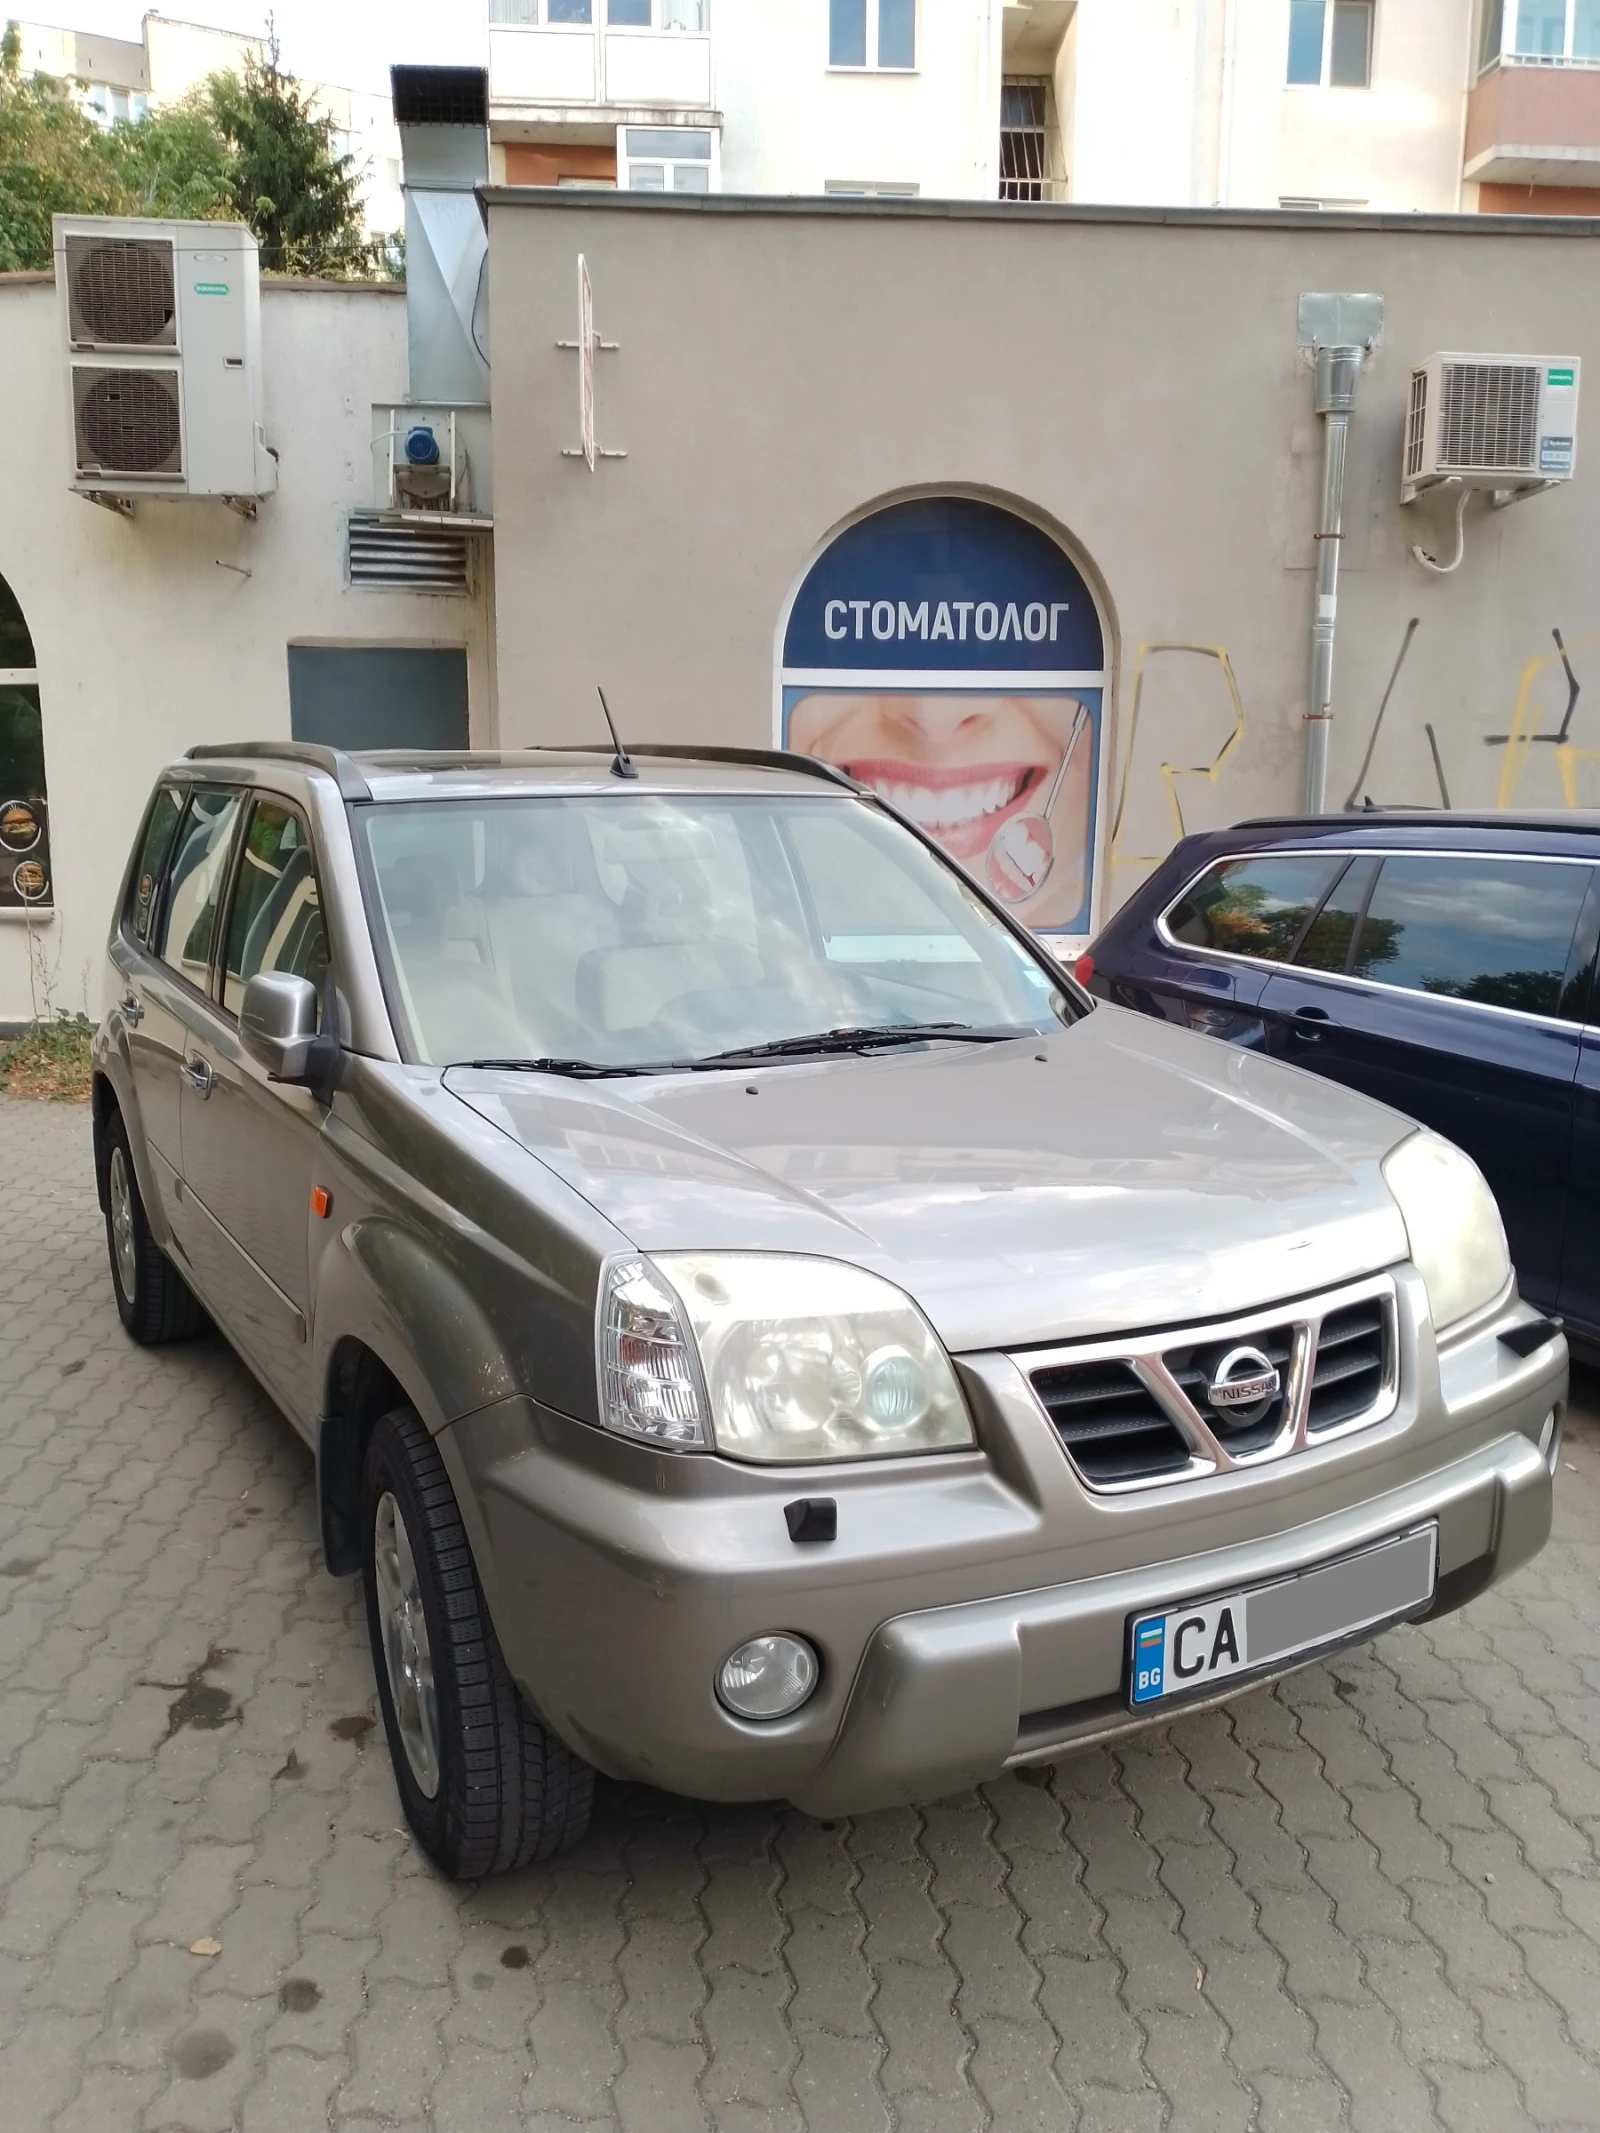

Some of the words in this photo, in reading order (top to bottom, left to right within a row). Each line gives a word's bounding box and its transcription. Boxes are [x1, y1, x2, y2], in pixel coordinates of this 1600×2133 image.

[824, 600, 1069, 641] СТОМАТОЛОГ
[1222, 1380, 1277, 1400] NISSAN
[1138, 1667, 1161, 1690] BG
